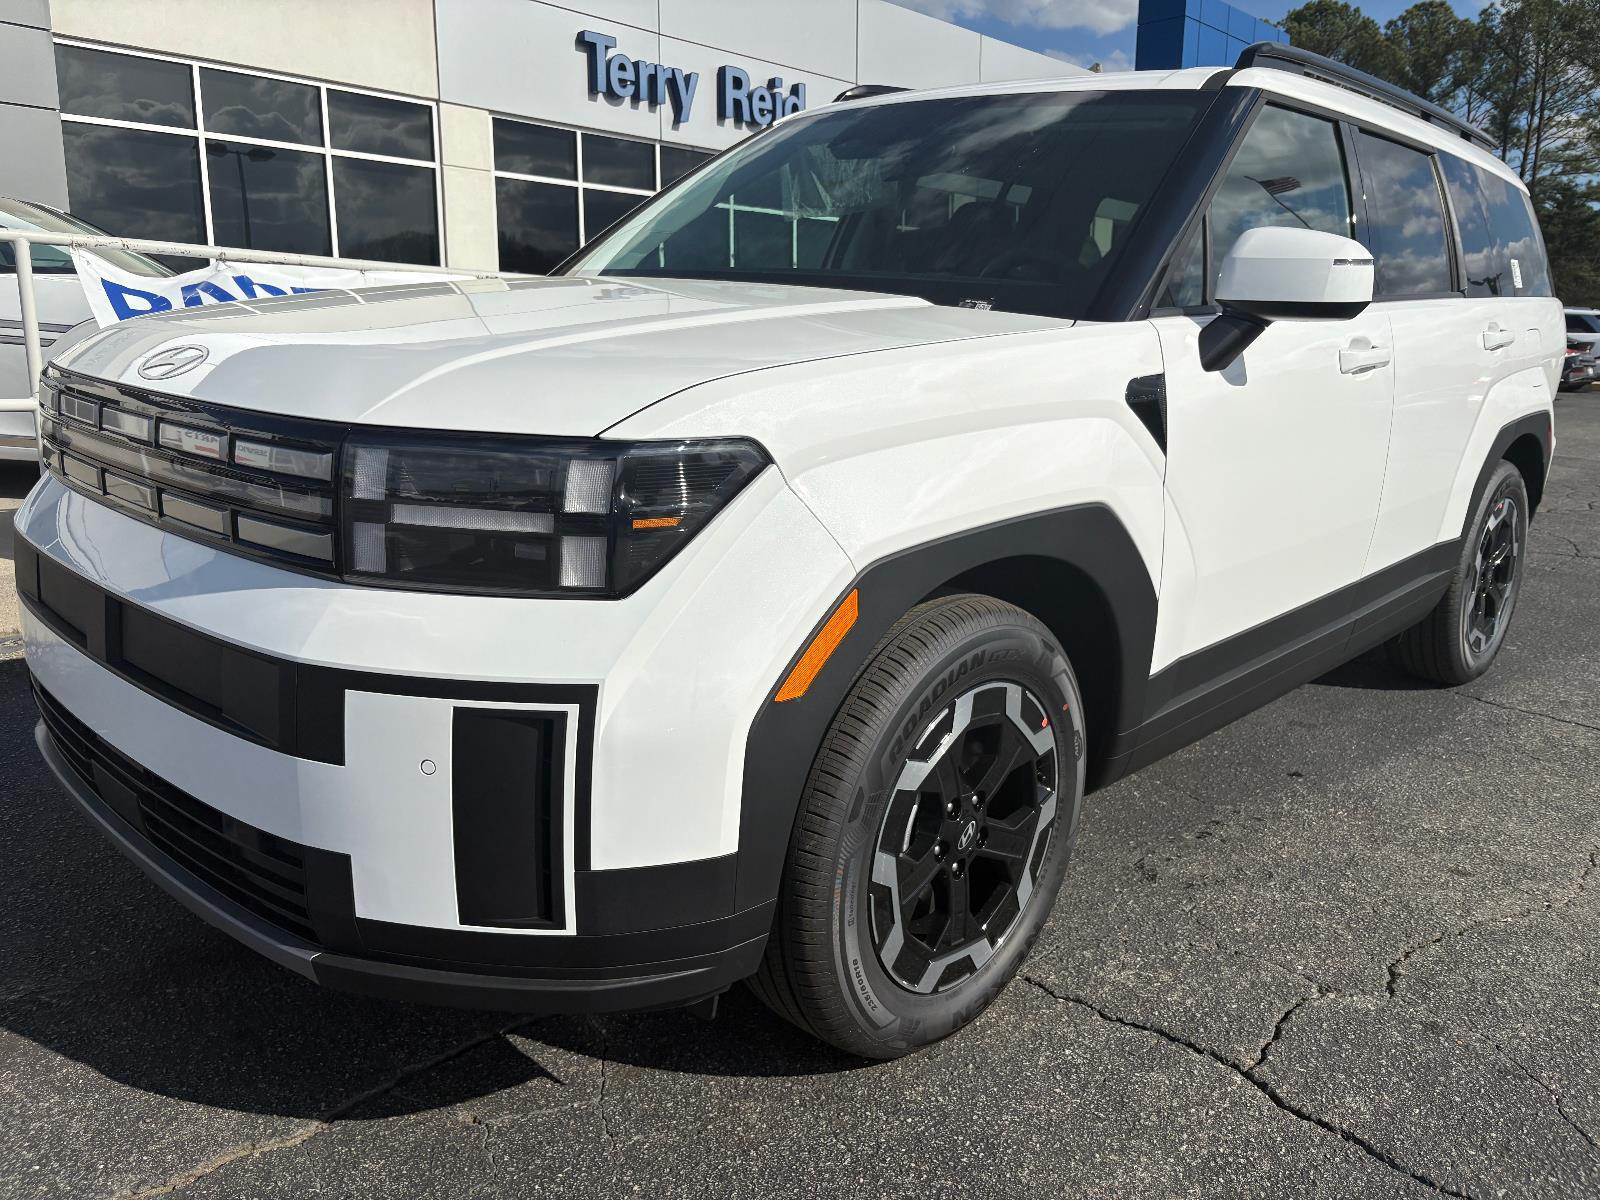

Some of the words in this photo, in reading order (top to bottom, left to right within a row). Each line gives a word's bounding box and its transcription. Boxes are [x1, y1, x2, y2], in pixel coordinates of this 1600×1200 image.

[577, 30, 699, 123] Terry
[717, 65, 806, 126] Reid
[888, 650, 987, 766] ROADIAN
